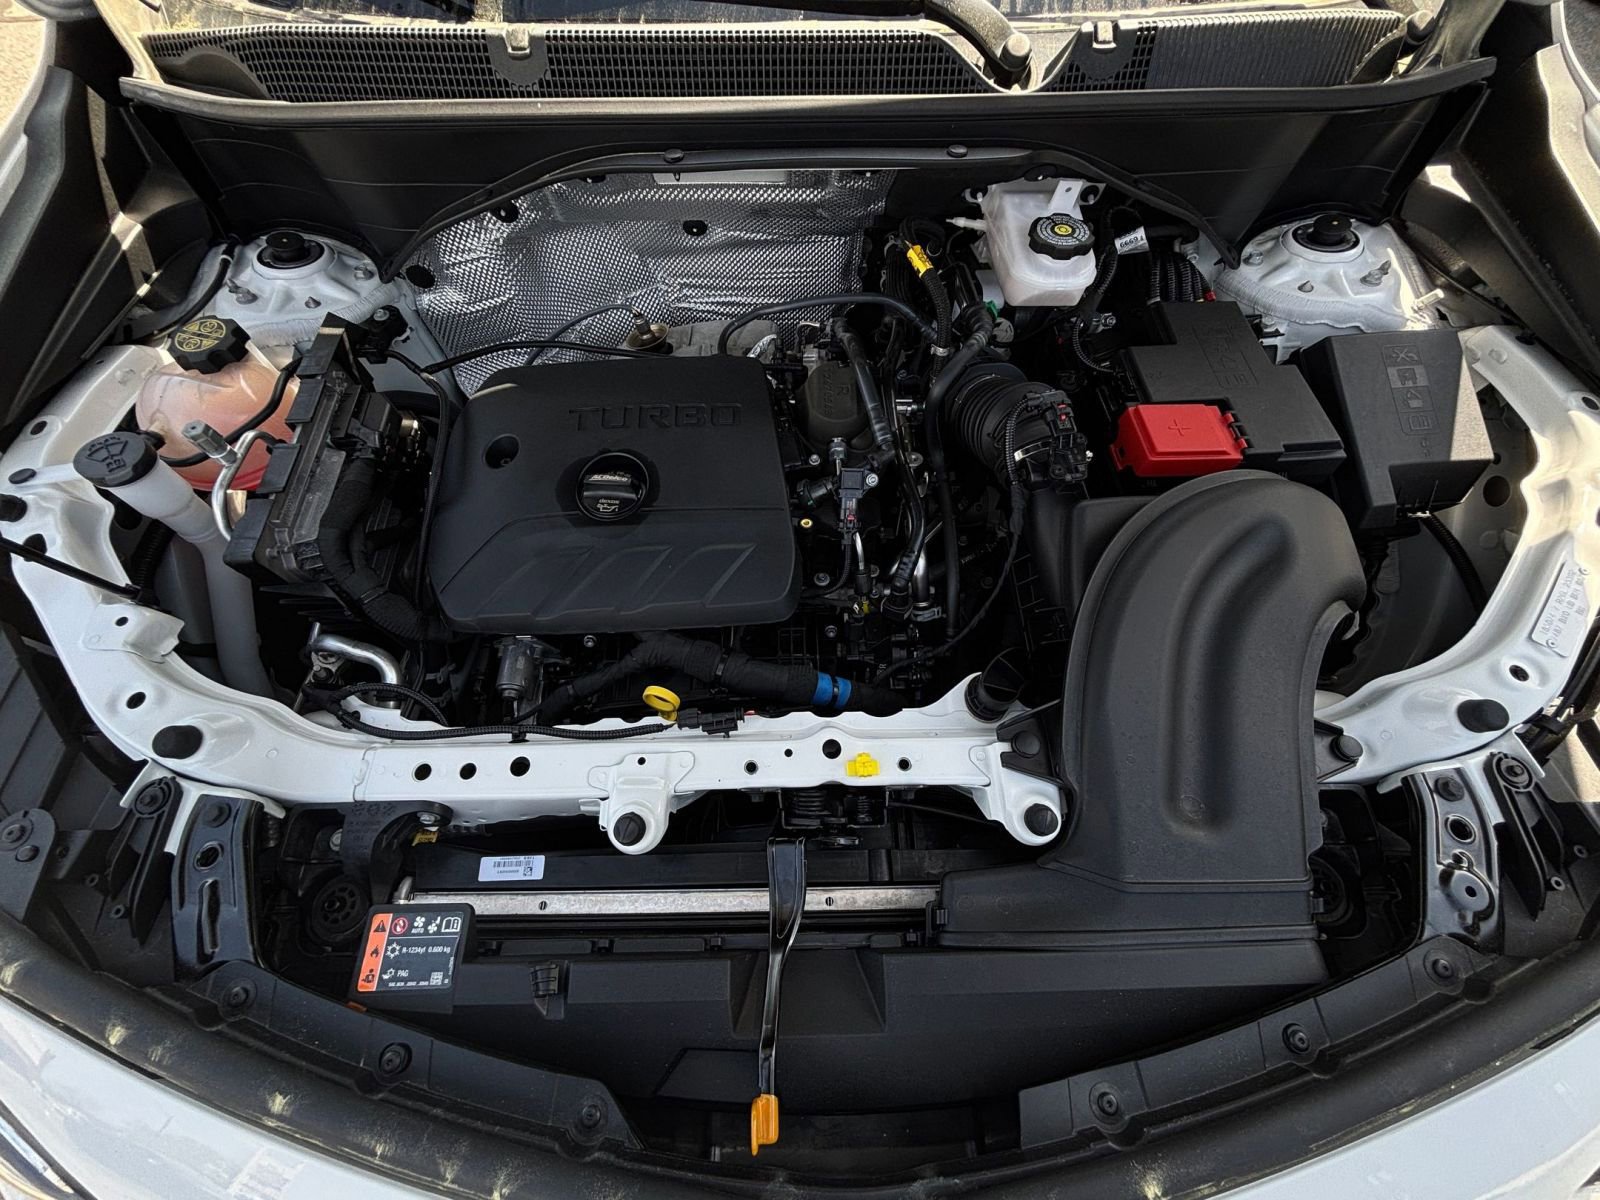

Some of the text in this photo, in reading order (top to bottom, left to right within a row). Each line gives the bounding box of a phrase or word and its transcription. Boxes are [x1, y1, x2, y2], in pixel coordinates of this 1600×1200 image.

[569, 402, 742, 431] TURBO
[402, 946, 426, 954] R-1234yf
[397, 969, 409, 977] PAG
